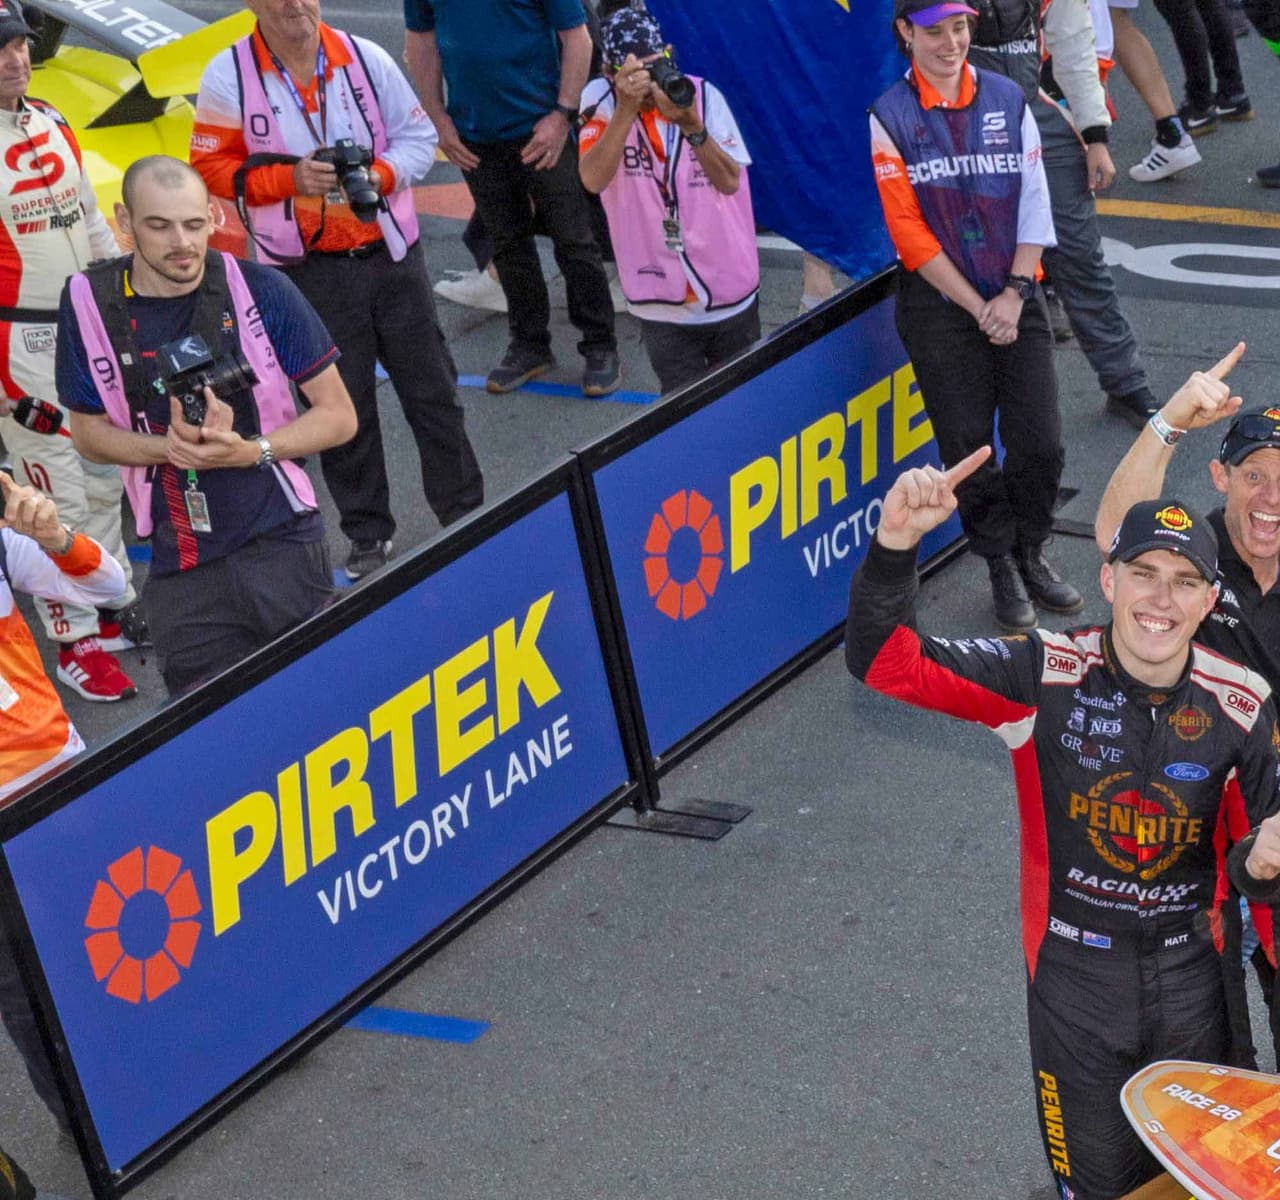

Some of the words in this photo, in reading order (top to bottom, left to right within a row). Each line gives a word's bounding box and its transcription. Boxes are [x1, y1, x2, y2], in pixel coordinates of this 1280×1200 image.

[729, 362, 935, 574] PIRTE
[802, 499, 884, 580] VICTO
[1047, 655, 1077, 673] OMP
[1226, 693, 1257, 714] OMP
[1088, 718, 1123, 736] NED
[1168, 714, 1213, 729] PENRITE
[1060, 732, 1121, 763] GROVE
[1077, 754, 1102, 772] HIRE
[206, 590, 562, 938] PIRTEK
[1168, 764, 1205, 779] Ford
[316, 780, 474, 926] VICTORY
[485, 714, 575, 806] LANE
[1068, 791, 1203, 845] PENRITE
[1066, 866, 1161, 902] RACING
[1049, 917, 1079, 939] OMP
[1163, 933, 1190, 948] MATT
[1160, 1081, 1208, 1114] RACE
[1206, 1100, 1243, 1123] 26
[1038, 1069, 1071, 1178] PENRITE
